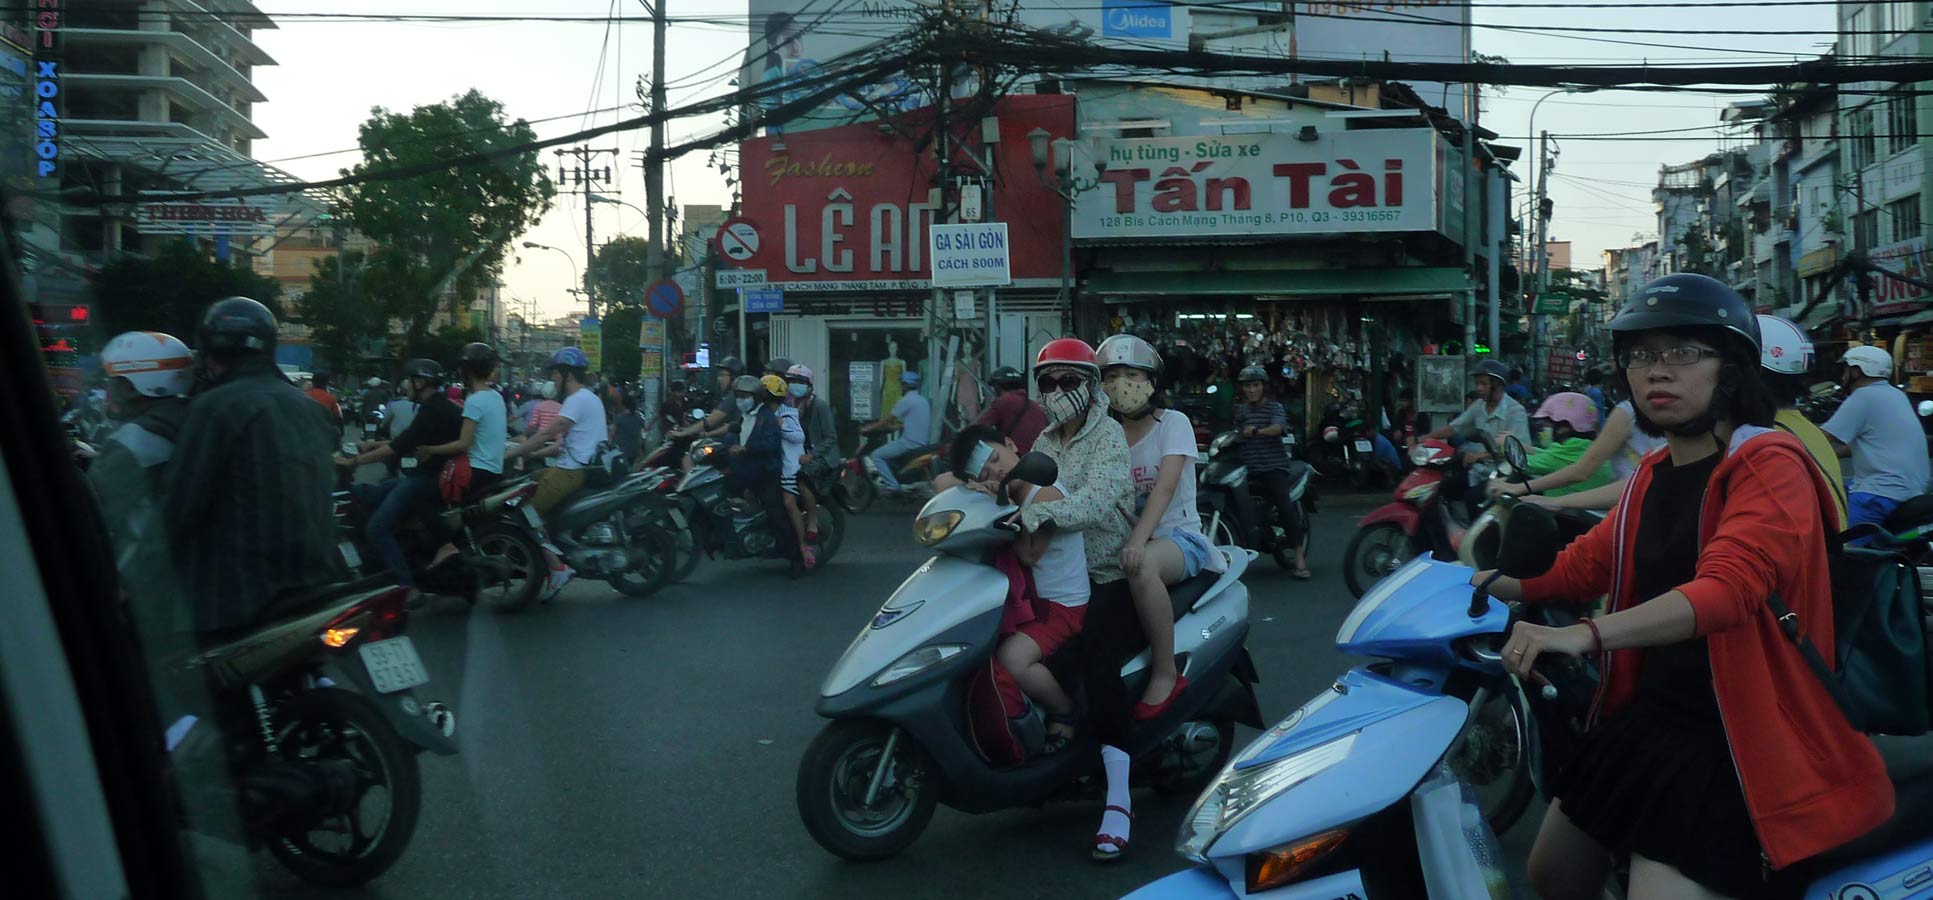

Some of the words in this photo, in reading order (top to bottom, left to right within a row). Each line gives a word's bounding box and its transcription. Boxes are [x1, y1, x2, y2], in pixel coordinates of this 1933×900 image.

[1118, 12, 1168, 29] Midea
[1110, 146, 1133, 164] hụ
[1138, 145, 1180, 162] tùng
[1196, 139, 1232, 159] Sửa
[1239, 147, 1261, 156] xe
[765, 153, 875, 187] Fashion
[1101, 161, 1252, 214] Tấn
[1274, 159, 1403, 209] Tài
[966, 207, 977, 218] 65
[1100, 217, 1121, 228] 128
[1125, 215, 1145, 227] Bis
[1312, 212, 1330, 223] Q3
[1342, 211, 1402, 222] 39316567
[784, 187, 855, 274] LÊ
[936, 233, 952, 250] GA
[955, 228, 976, 250] SÀI
[979, 227, 1004, 249] GÒN
[972, 257, 1005, 269] 800M
